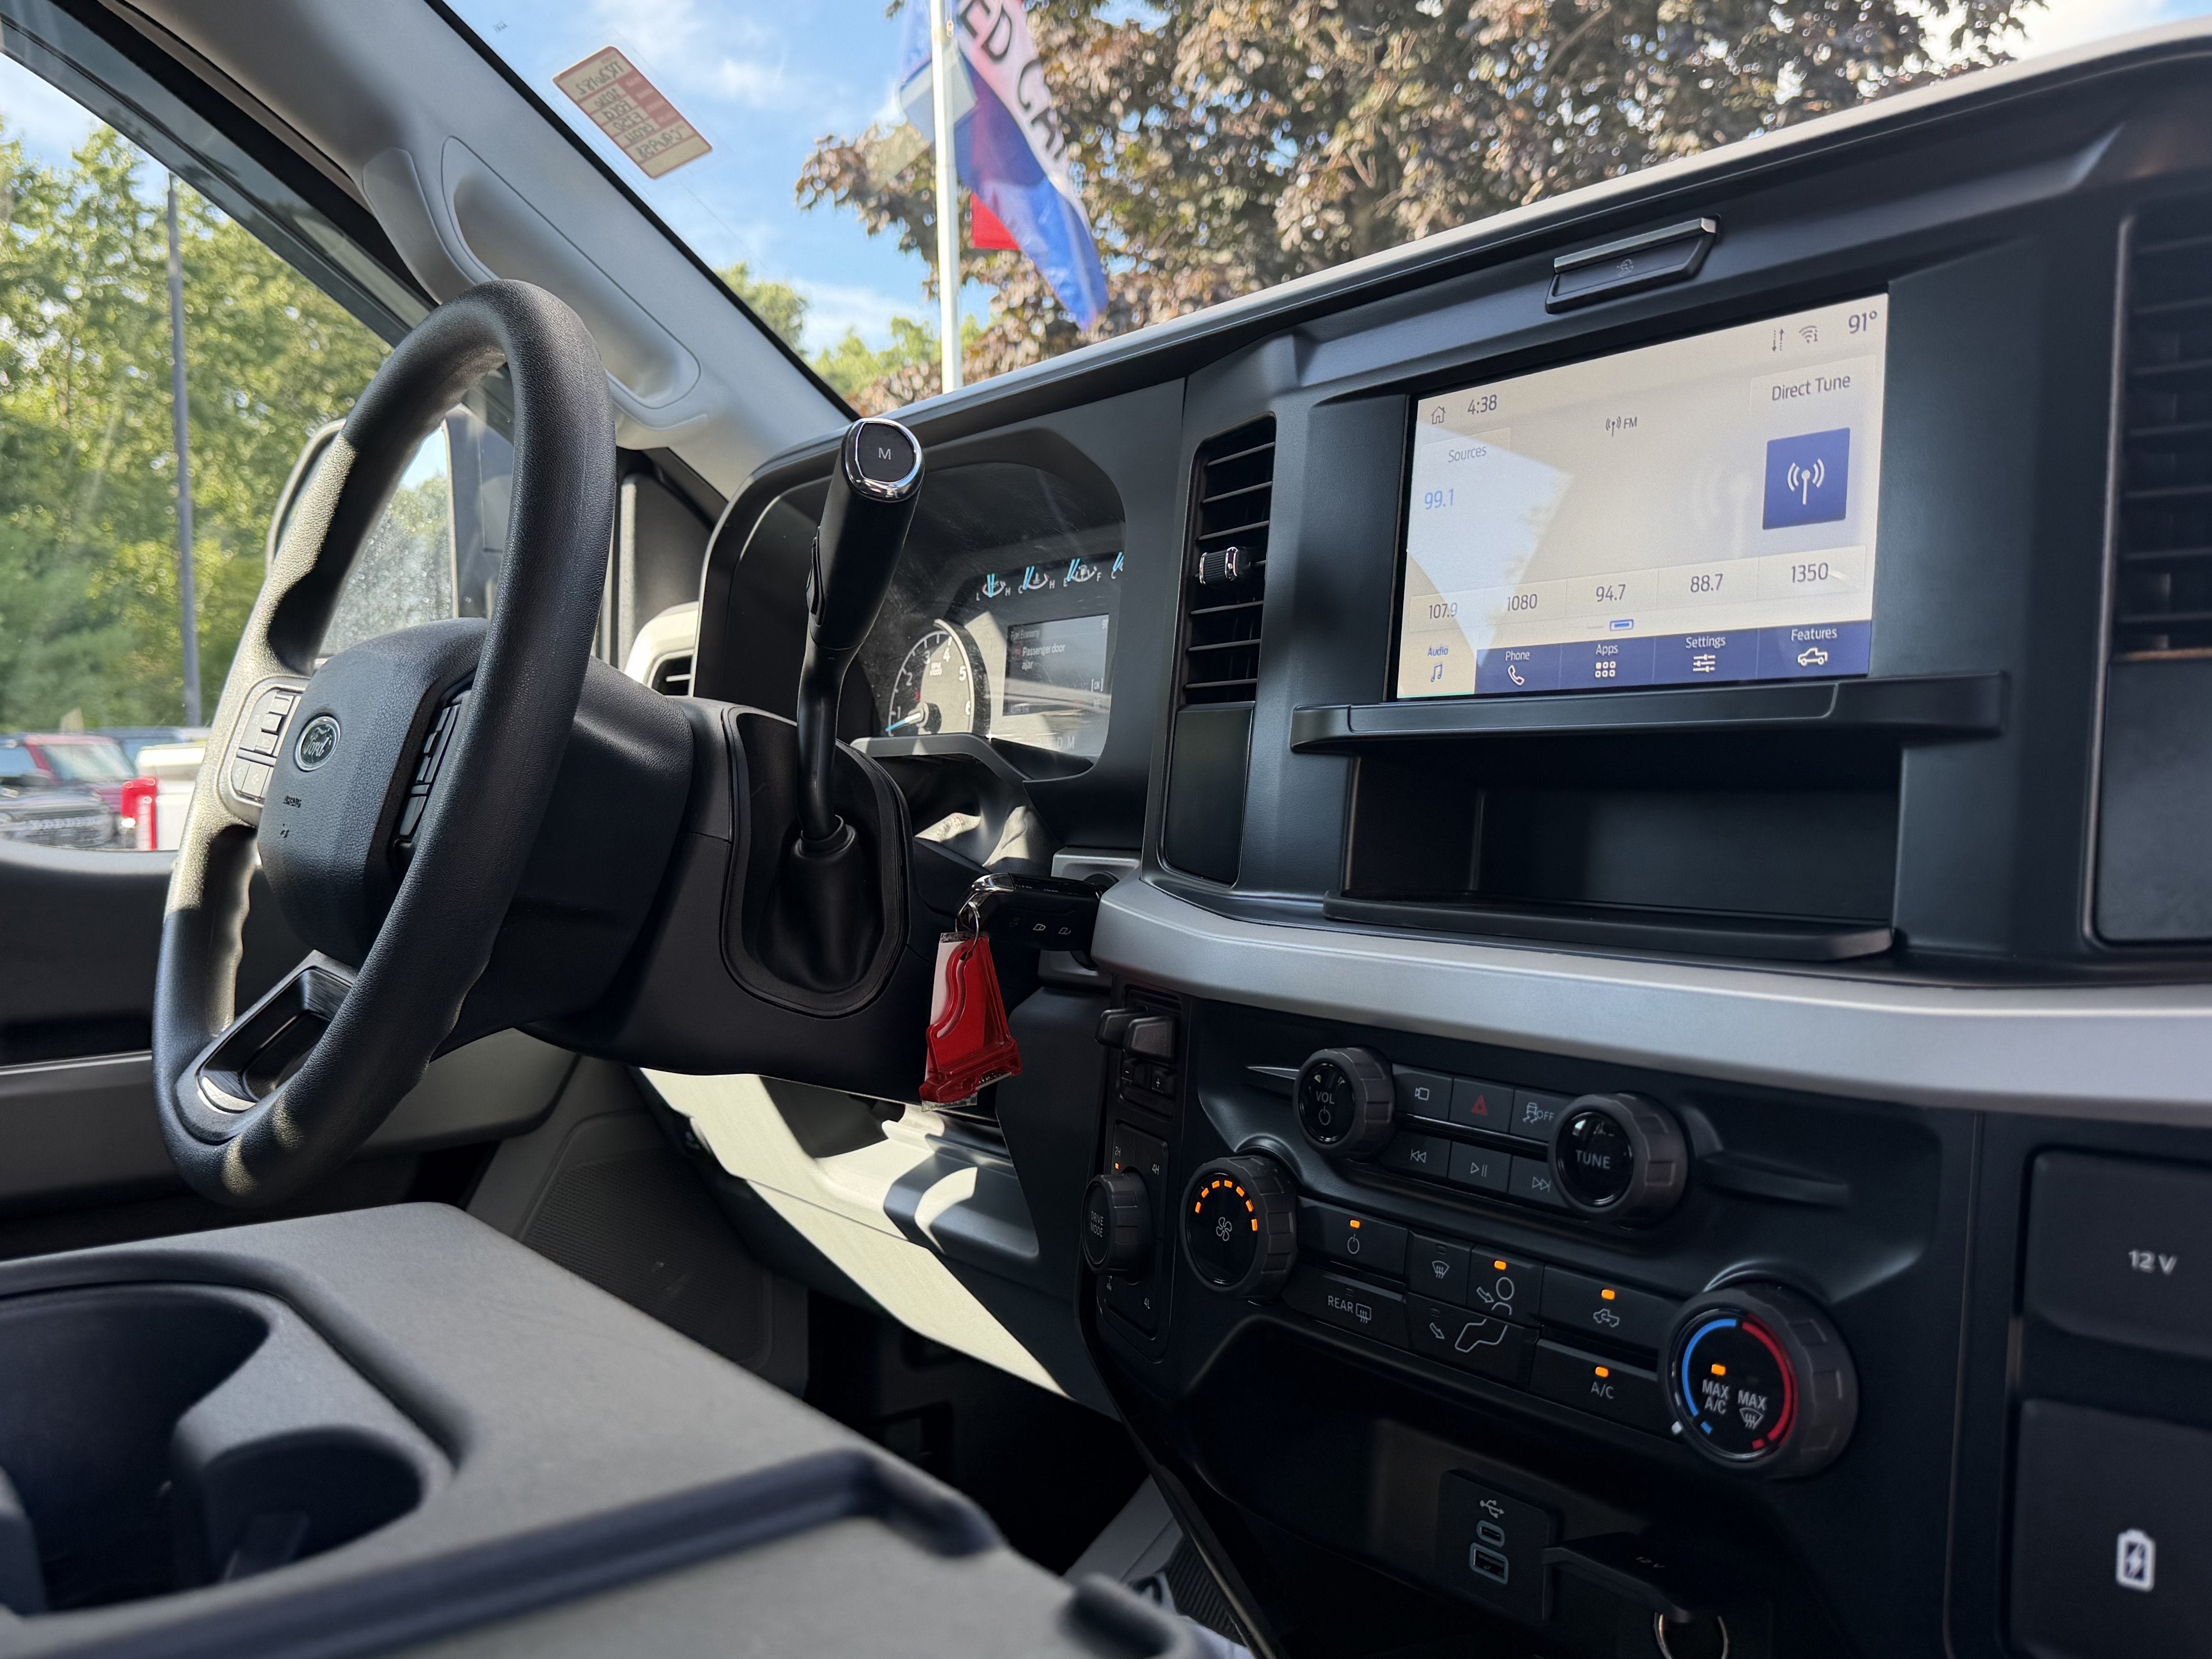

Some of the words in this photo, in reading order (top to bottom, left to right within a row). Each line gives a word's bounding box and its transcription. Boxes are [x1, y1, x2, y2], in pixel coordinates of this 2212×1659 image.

[1848, 311, 1877, 334] 91°
[1772, 381, 1811, 401] Direct
[1815, 375, 1851, 392] Tune
[1468, 394, 1497, 414] 4:38
[1624, 416, 1637, 429] FM
[878, 448, 892, 460] M
[1448, 446, 1486, 463] Sources
[1425, 488, 1454, 510] 99.1
[1096, 572, 1102, 582] F
[1791, 563, 1829, 583] 1350
[1018, 585, 1023, 594] C
[1049, 579, 1055, 589] H
[1063, 578, 1068, 587] E
[1690, 573, 1723, 593] 88.7
[1005, 587, 1011, 596] H
[1596, 584, 1626, 602] 94.7
[1507, 593, 1537, 611] 1080
[1429, 602, 1457, 619] 107.9
[1791, 627, 1837, 641] Features
[1686, 635, 1726, 649] Settings
[943, 647, 950, 662] 4
[1022, 646, 1051, 657] Passenger
[1051, 643, 1065, 653] door
[1427, 646, 1448, 657] Audio
[1506, 651, 1530, 661] Phone
[1596, 644, 1618, 655] Apps
[923, 650, 930, 664] 3
[1021, 660, 1034, 671] ajar
[906, 672, 913, 686] 2
[959, 665, 967, 681] 5
[897, 706, 901, 719] 1
[1315, 1091, 1335, 1105] VOL
[1537, 1110, 1554, 1121] OFF
[1115, 1146, 1121, 1156] 2H
[1575, 1150, 1611, 1169] TUNE
[1152, 1164, 1160, 1175] 4H
[1091, 1210, 1104, 1226] DRIVE
[1090, 1222, 1103, 1238] MODE
[1144, 1298, 1151, 1309] 4L
[1327, 1295, 1354, 1314] REAR
[1591, 1381, 1614, 1400] A/C
[1702, 1378, 1730, 1400] MAX
[1704, 1396, 1726, 1414] A/C
[1738, 1389, 1768, 1411] MAX
